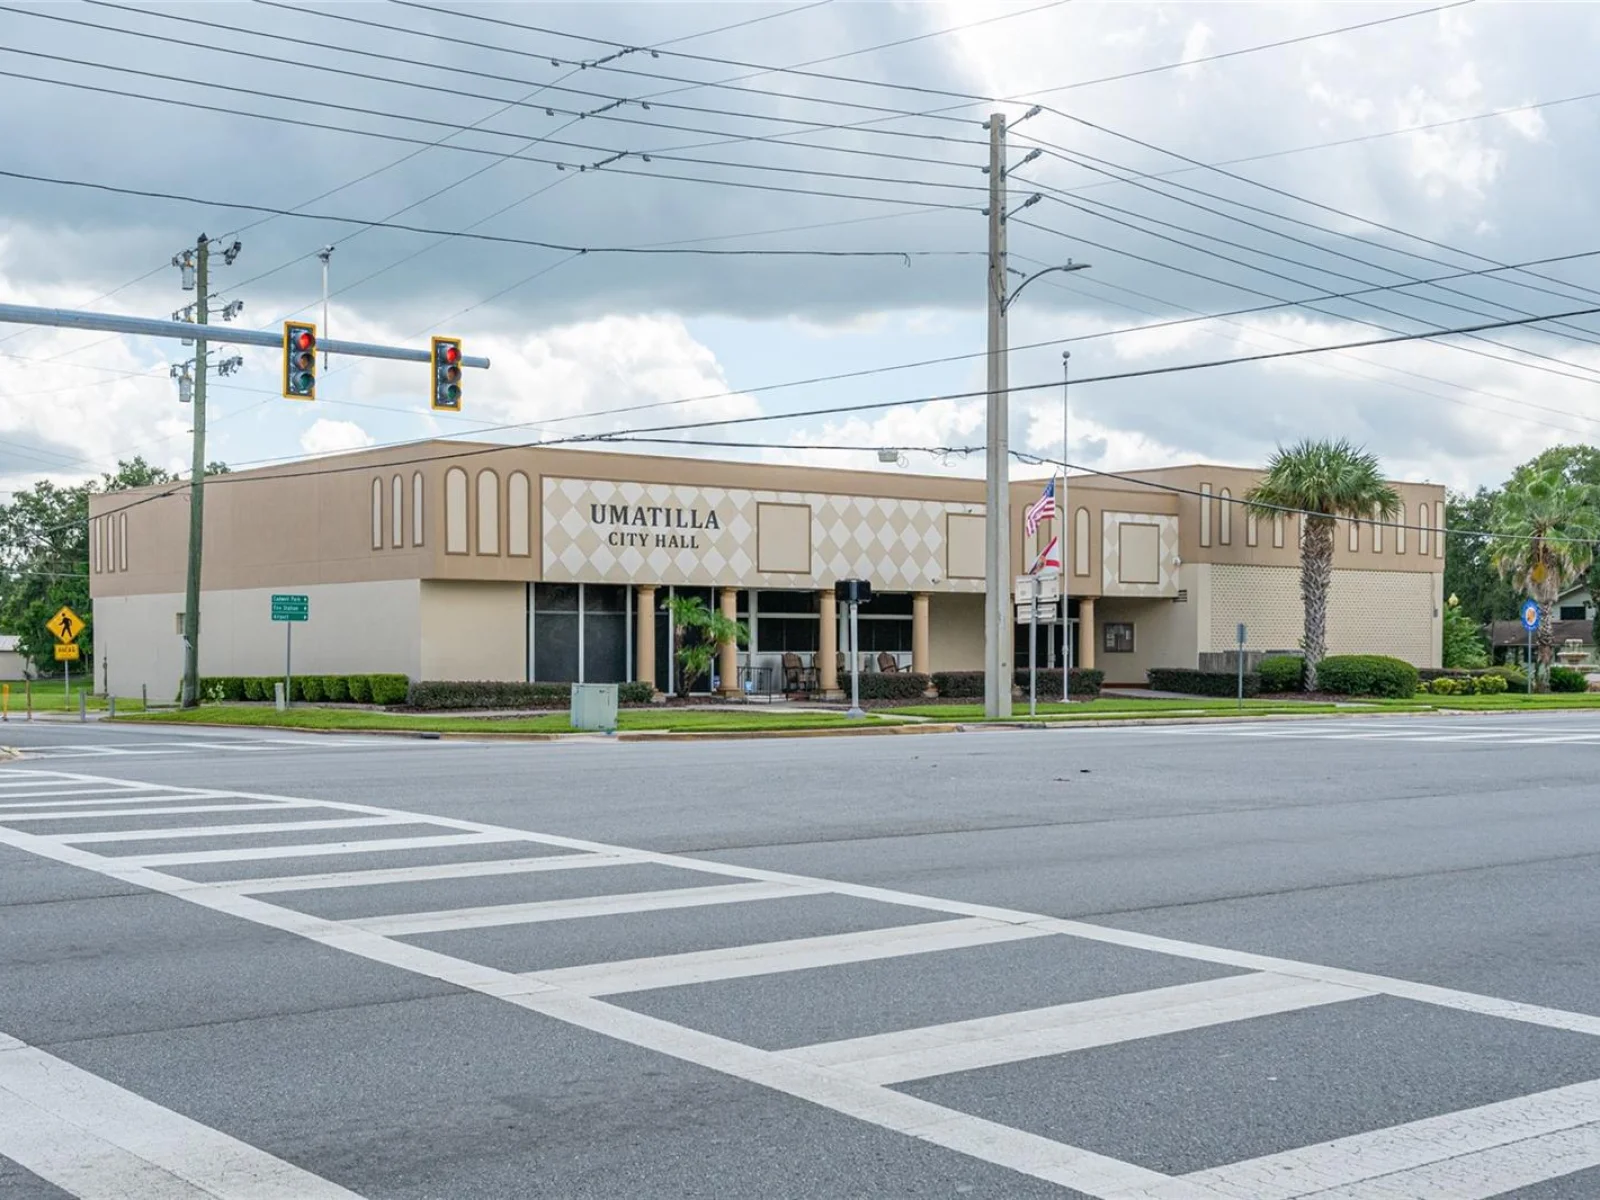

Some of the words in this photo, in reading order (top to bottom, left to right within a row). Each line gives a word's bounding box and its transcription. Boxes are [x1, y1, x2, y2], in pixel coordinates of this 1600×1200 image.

[591, 504, 720, 530] UMATILLA
[608, 532, 649, 547] CITY
[655, 534, 699, 549] HALL
